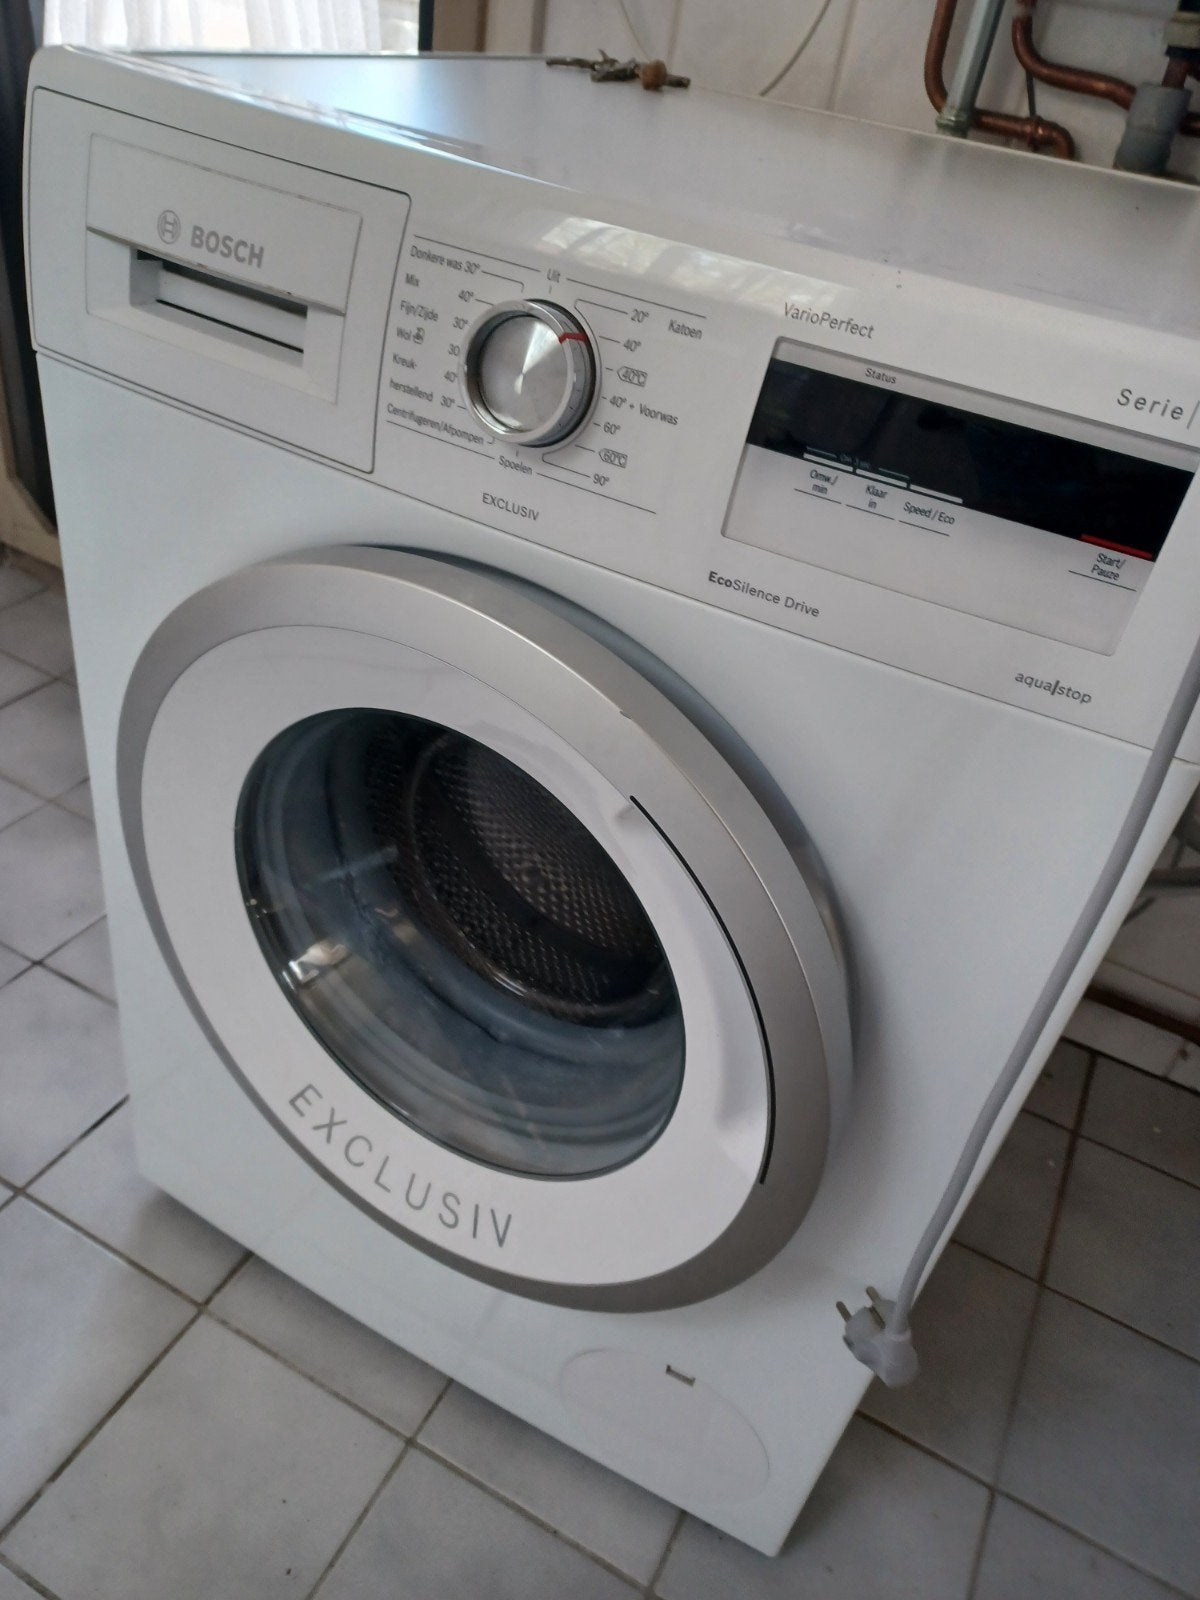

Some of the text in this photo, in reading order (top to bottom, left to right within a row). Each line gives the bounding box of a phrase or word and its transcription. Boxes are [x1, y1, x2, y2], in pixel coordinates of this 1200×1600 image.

[191, 224, 265, 268] BOSCH
[409, 245, 445, 266] Donkere
[446, 257, 463, 271] was
[405, 273, 420, 287] Mix
[400, 300, 439, 322] Fijn/Zijde
[630, 308, 650, 323] 20°
[784, 302, 875, 339] VarioPerfect
[396, 326, 412, 341] Wol
[668, 319, 703, 340] Katoen
[622, 338, 642, 352] 40°
[865, 368, 897, 384] Status
[389, 378, 434, 402] herstellend
[639, 402, 679, 426] Voorwas
[1117, 388, 1184, 420] Serie
[386, 402, 484, 445] Centrifugeren/Afpompen
[603, 421, 621, 435] 60°
[499, 455, 533, 475] Spoelen
[592, 473, 610, 487] 90°
[812, 483, 828, 495] min
[865, 485, 888, 499] Klaar
[482, 492, 540, 521] EXCLUSIV
[868, 499, 878, 510] in
[903, 501, 932, 519] Speed
[938, 511, 955, 525] Eco
[1096, 553, 1127, 569] Start/
[1091, 564, 1120, 581] Pauze
[708, 571, 820, 618] EcoSilence Drive
[288, 1083, 512, 1249] EXCLUSIV
